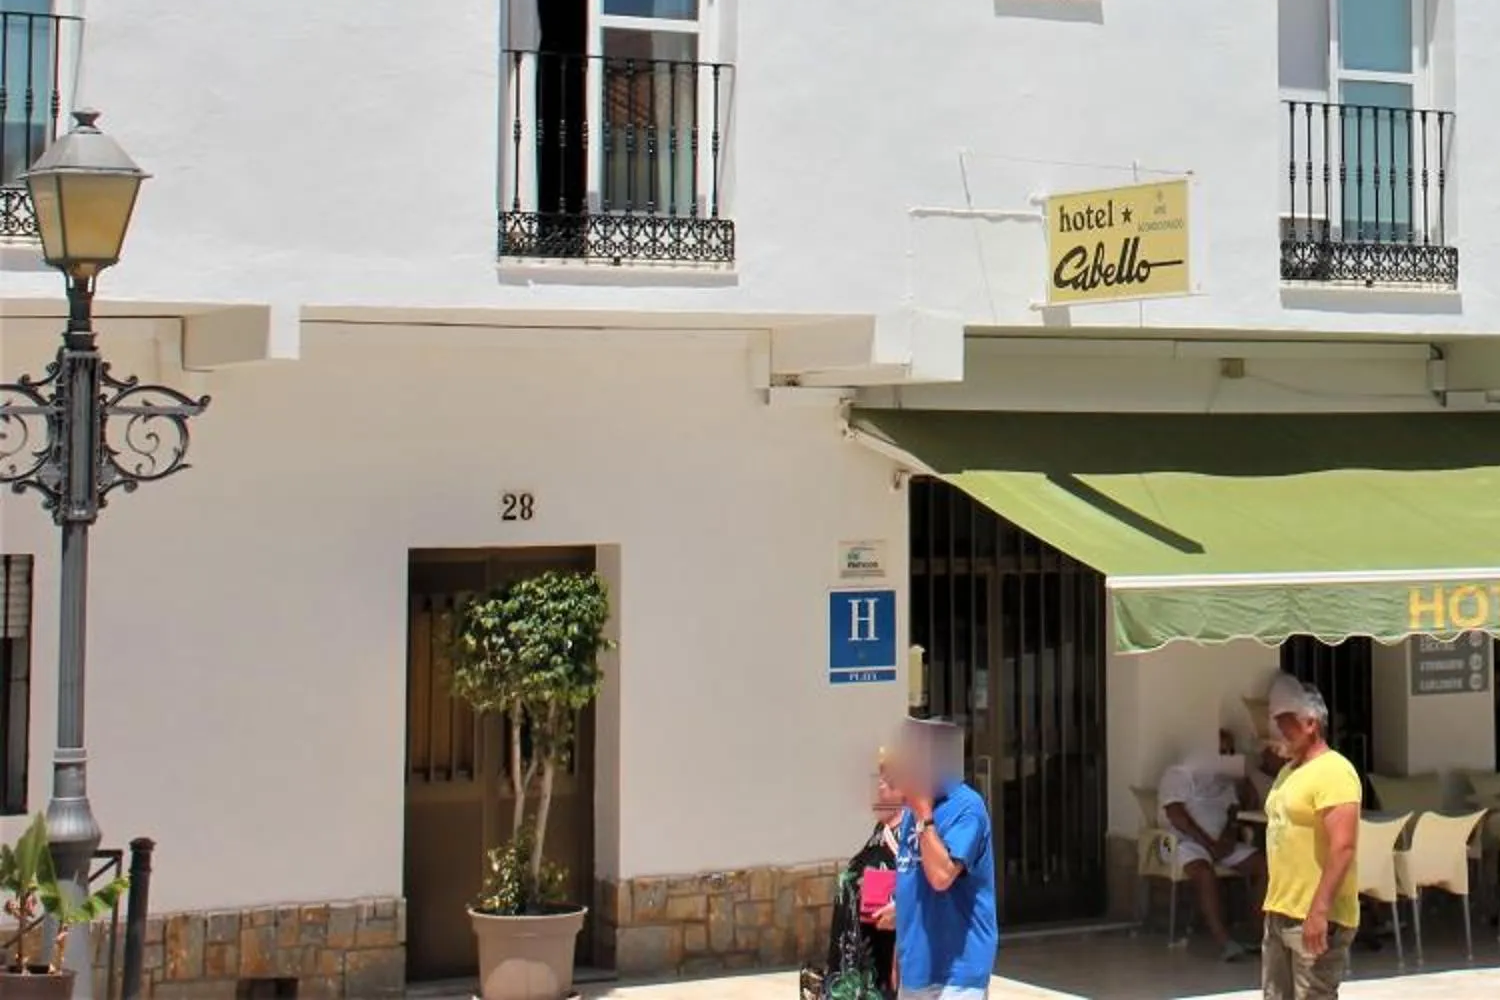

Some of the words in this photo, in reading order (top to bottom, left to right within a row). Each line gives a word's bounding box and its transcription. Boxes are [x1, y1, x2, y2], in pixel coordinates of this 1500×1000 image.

[1058, 199, 1115, 233] hotel
[1053, 235, 1184, 292] Cabello
[501, 492, 534, 521] 28
[847, 597, 880, 642] H
